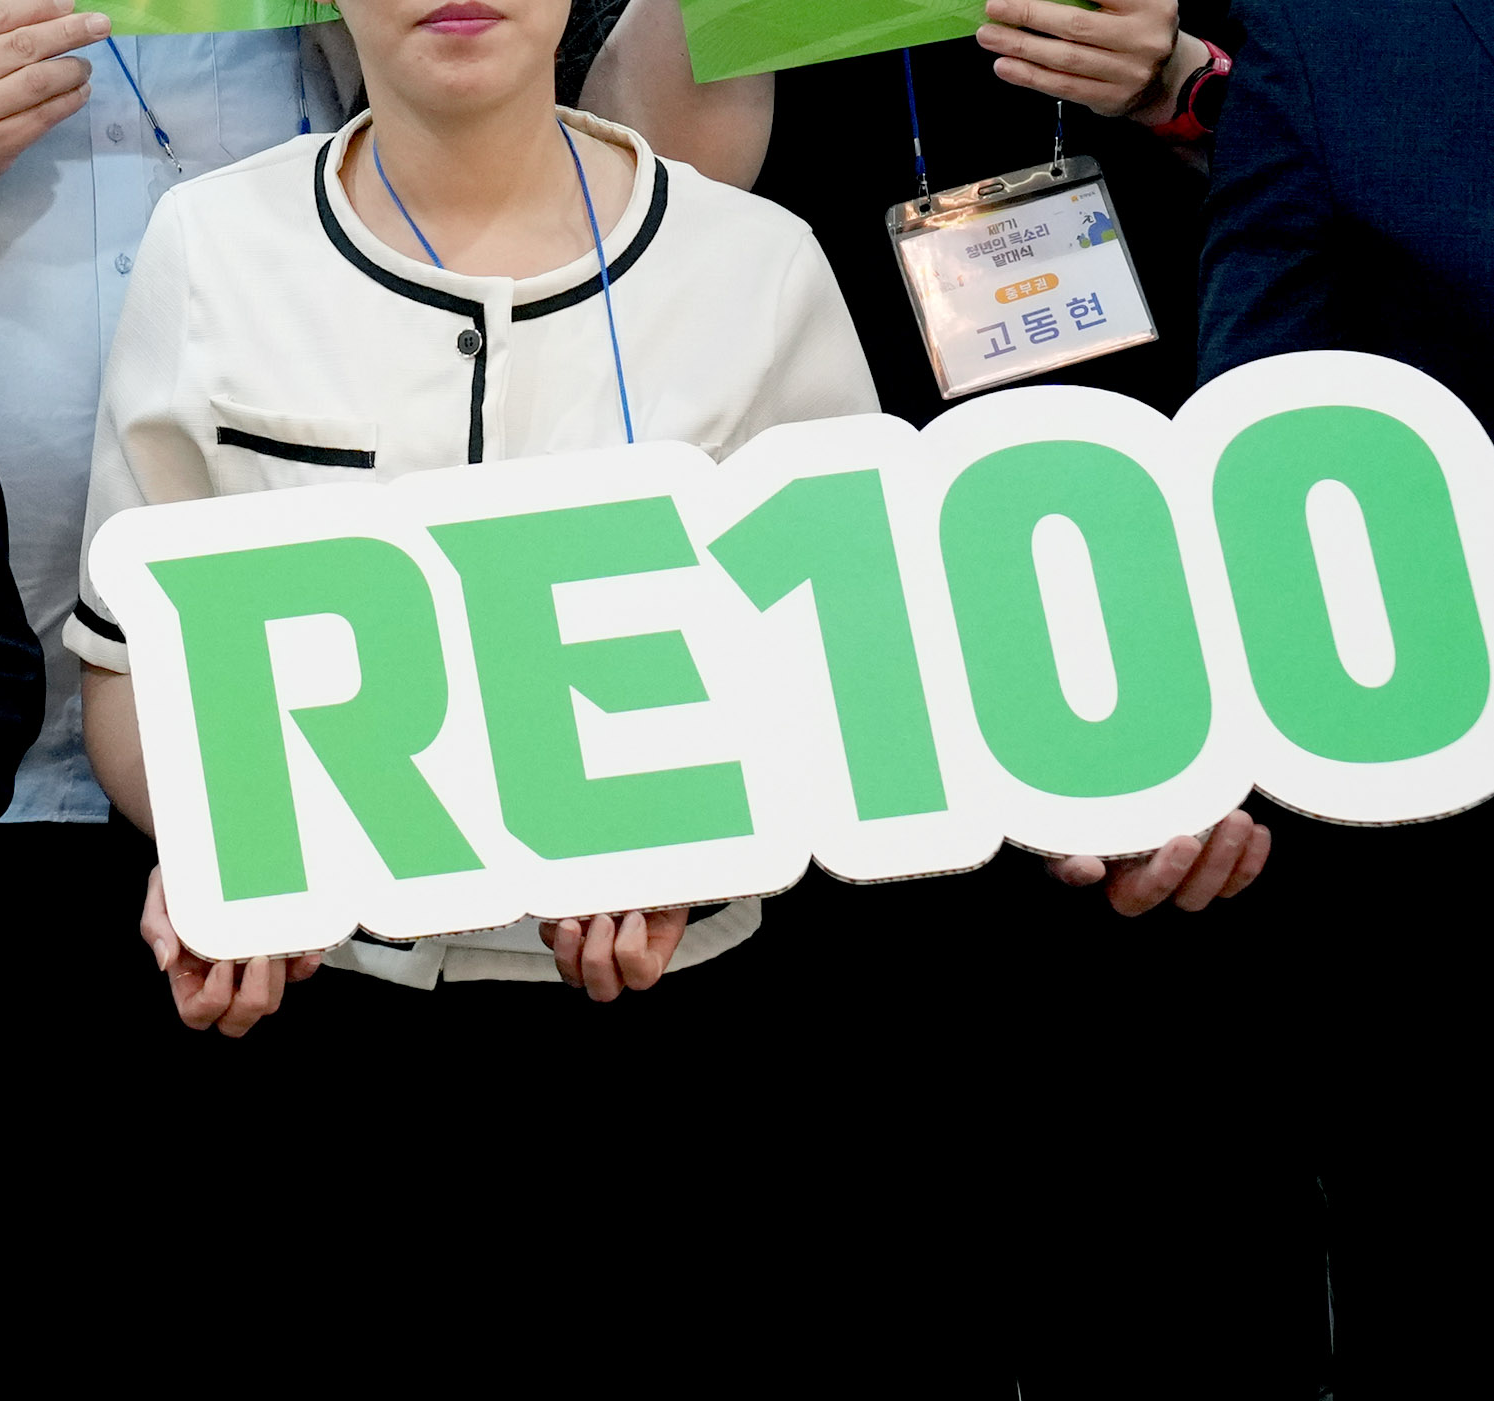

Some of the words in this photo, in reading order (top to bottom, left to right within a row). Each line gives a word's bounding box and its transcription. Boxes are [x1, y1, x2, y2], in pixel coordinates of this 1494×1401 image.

[965, 237, 1007, 259] 청년의
[1008, 224, 1050, 245] 목소리
[988, 219, 1018, 236] 제7기
[992, 245, 1034, 267] 발대식
[1005, 277, 1049, 300] 중부권
[976, 292, 1107, 360] 고동현
[144, 404, 1492, 902] RE100
